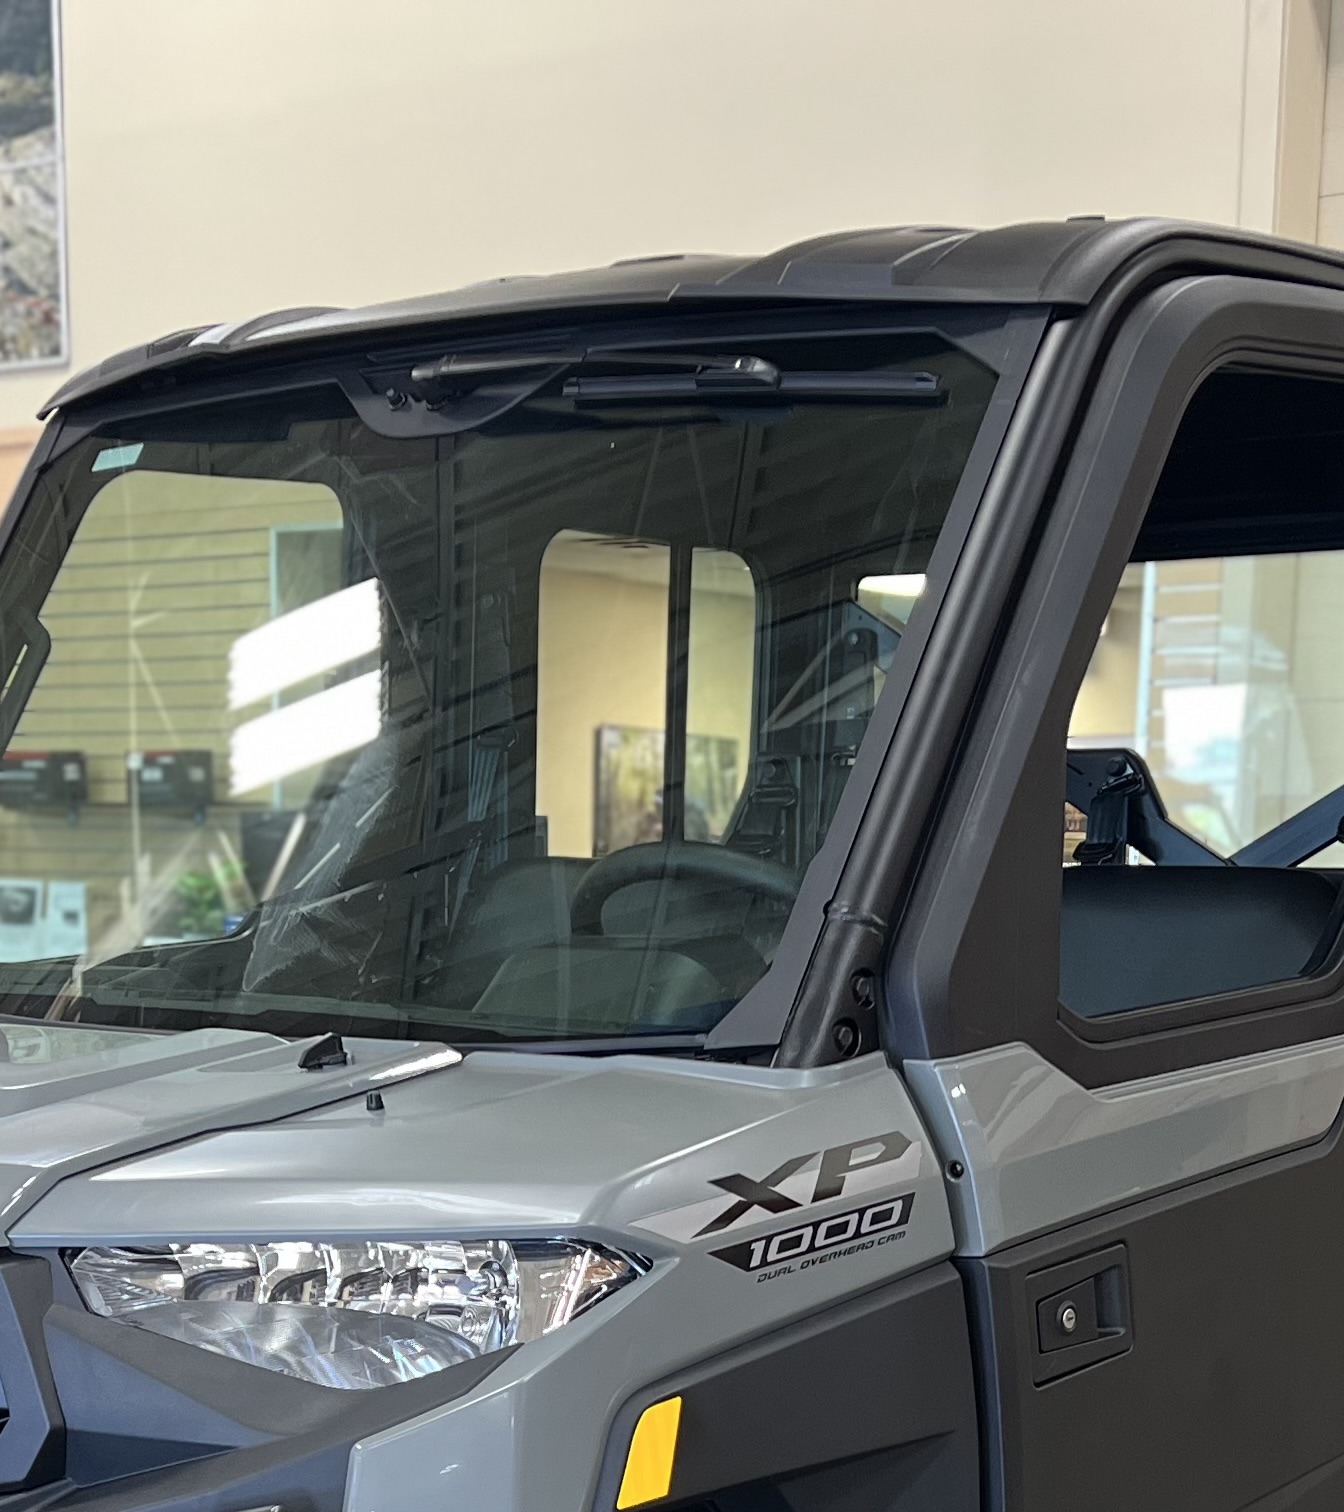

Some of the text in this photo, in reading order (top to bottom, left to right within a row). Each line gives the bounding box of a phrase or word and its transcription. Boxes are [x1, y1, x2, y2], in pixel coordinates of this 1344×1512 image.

[690, 1130, 913, 1240] XP
[748, 1198, 904, 1268] 1000
[756, 1229, 907, 1284] DUAL OVERHEAD CAM
